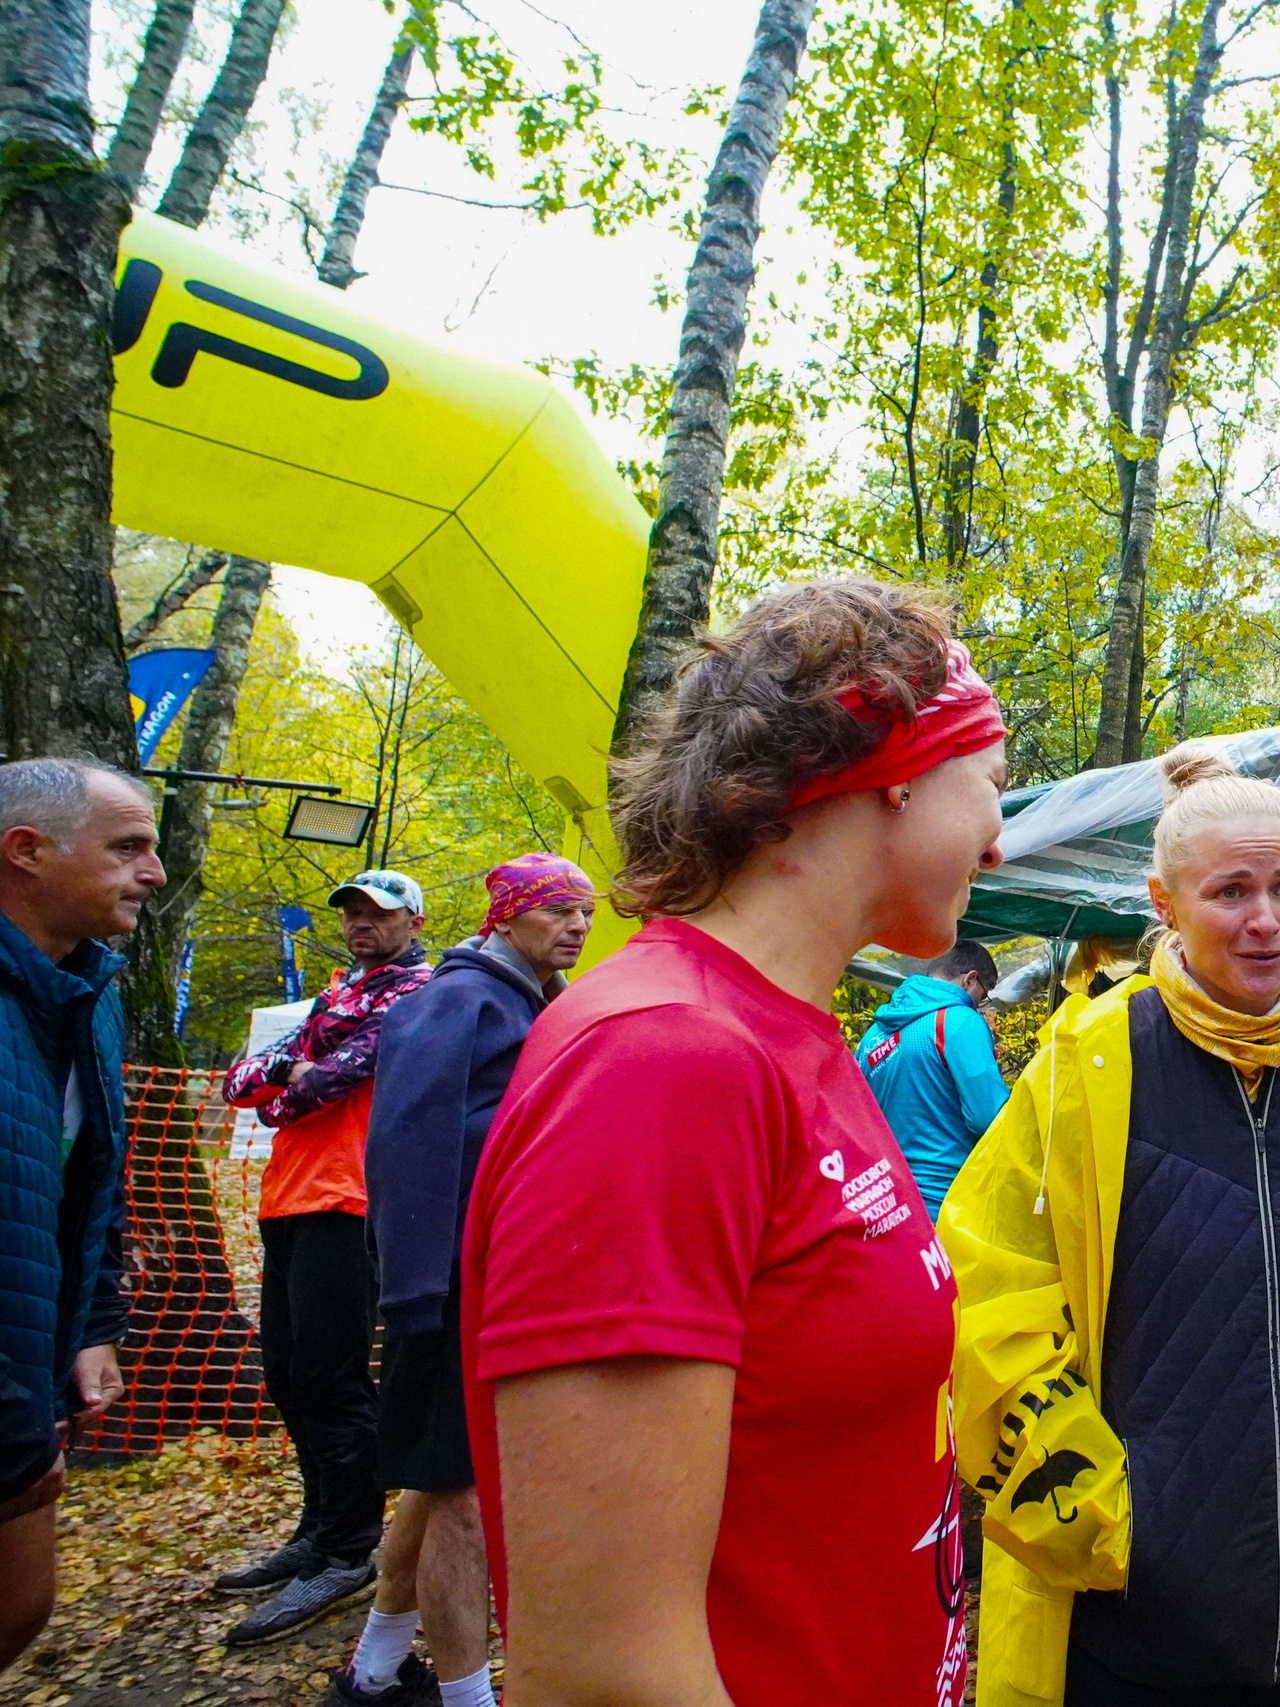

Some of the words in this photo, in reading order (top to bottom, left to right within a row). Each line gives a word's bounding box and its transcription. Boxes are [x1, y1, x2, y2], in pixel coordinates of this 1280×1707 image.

[870, 1035, 897, 1063] TIME
[860, 1192, 897, 1226] MOSCOW
[862, 1202, 912, 1242] MARATHON
